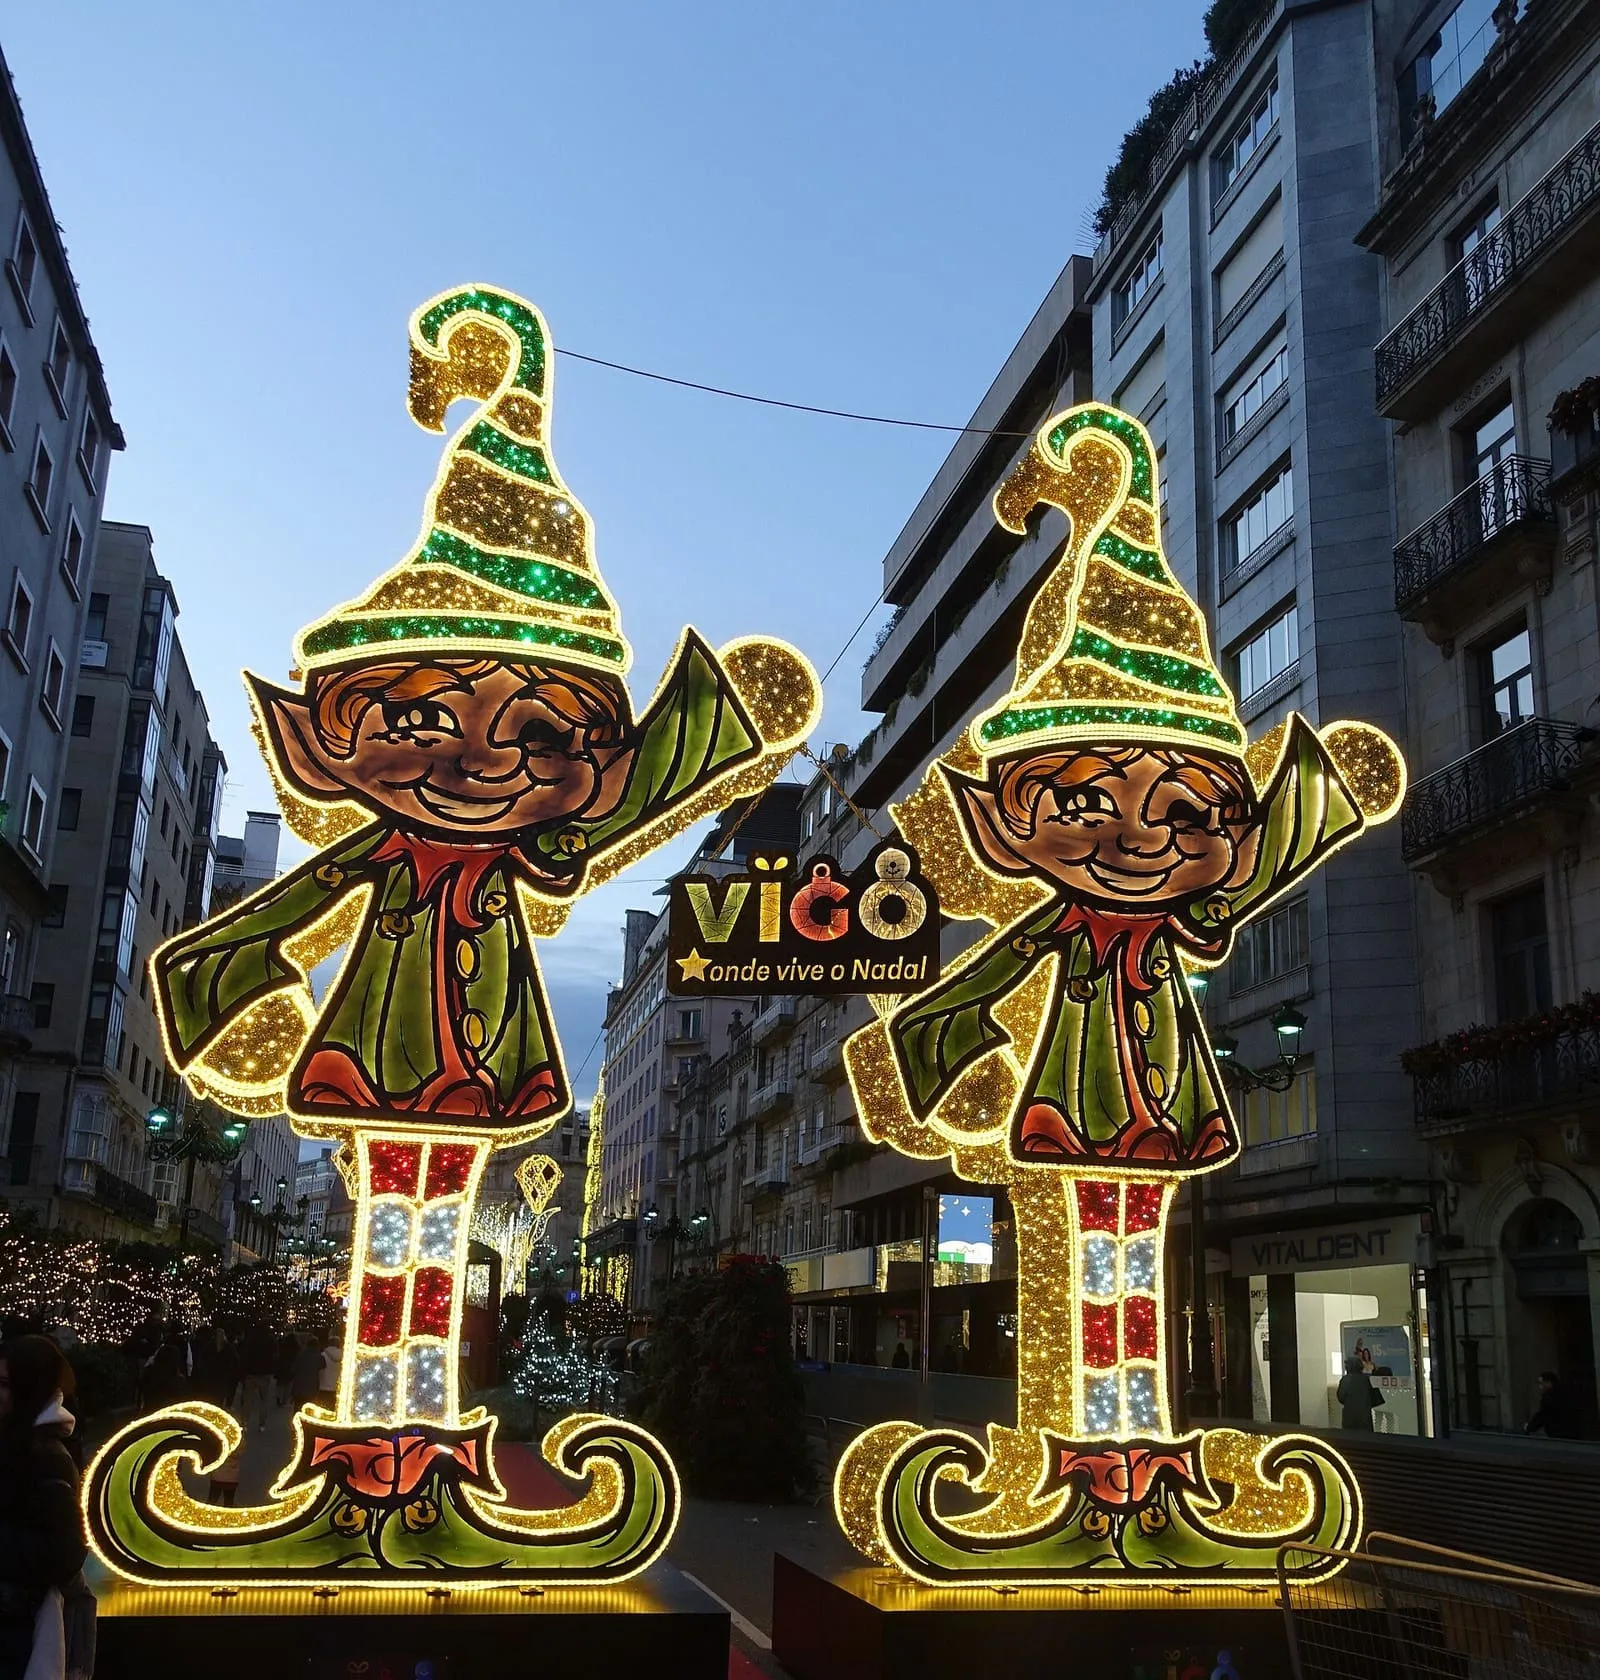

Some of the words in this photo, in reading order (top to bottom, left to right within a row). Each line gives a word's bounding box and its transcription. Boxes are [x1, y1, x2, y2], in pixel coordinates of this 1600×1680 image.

[709, 957, 771, 982] onde
[777, 956, 825, 982] vive
[830, 963, 845, 982] o
[851, 955, 928, 981] Nadal
[1251, 1228, 1392, 1267] VITALDENT
